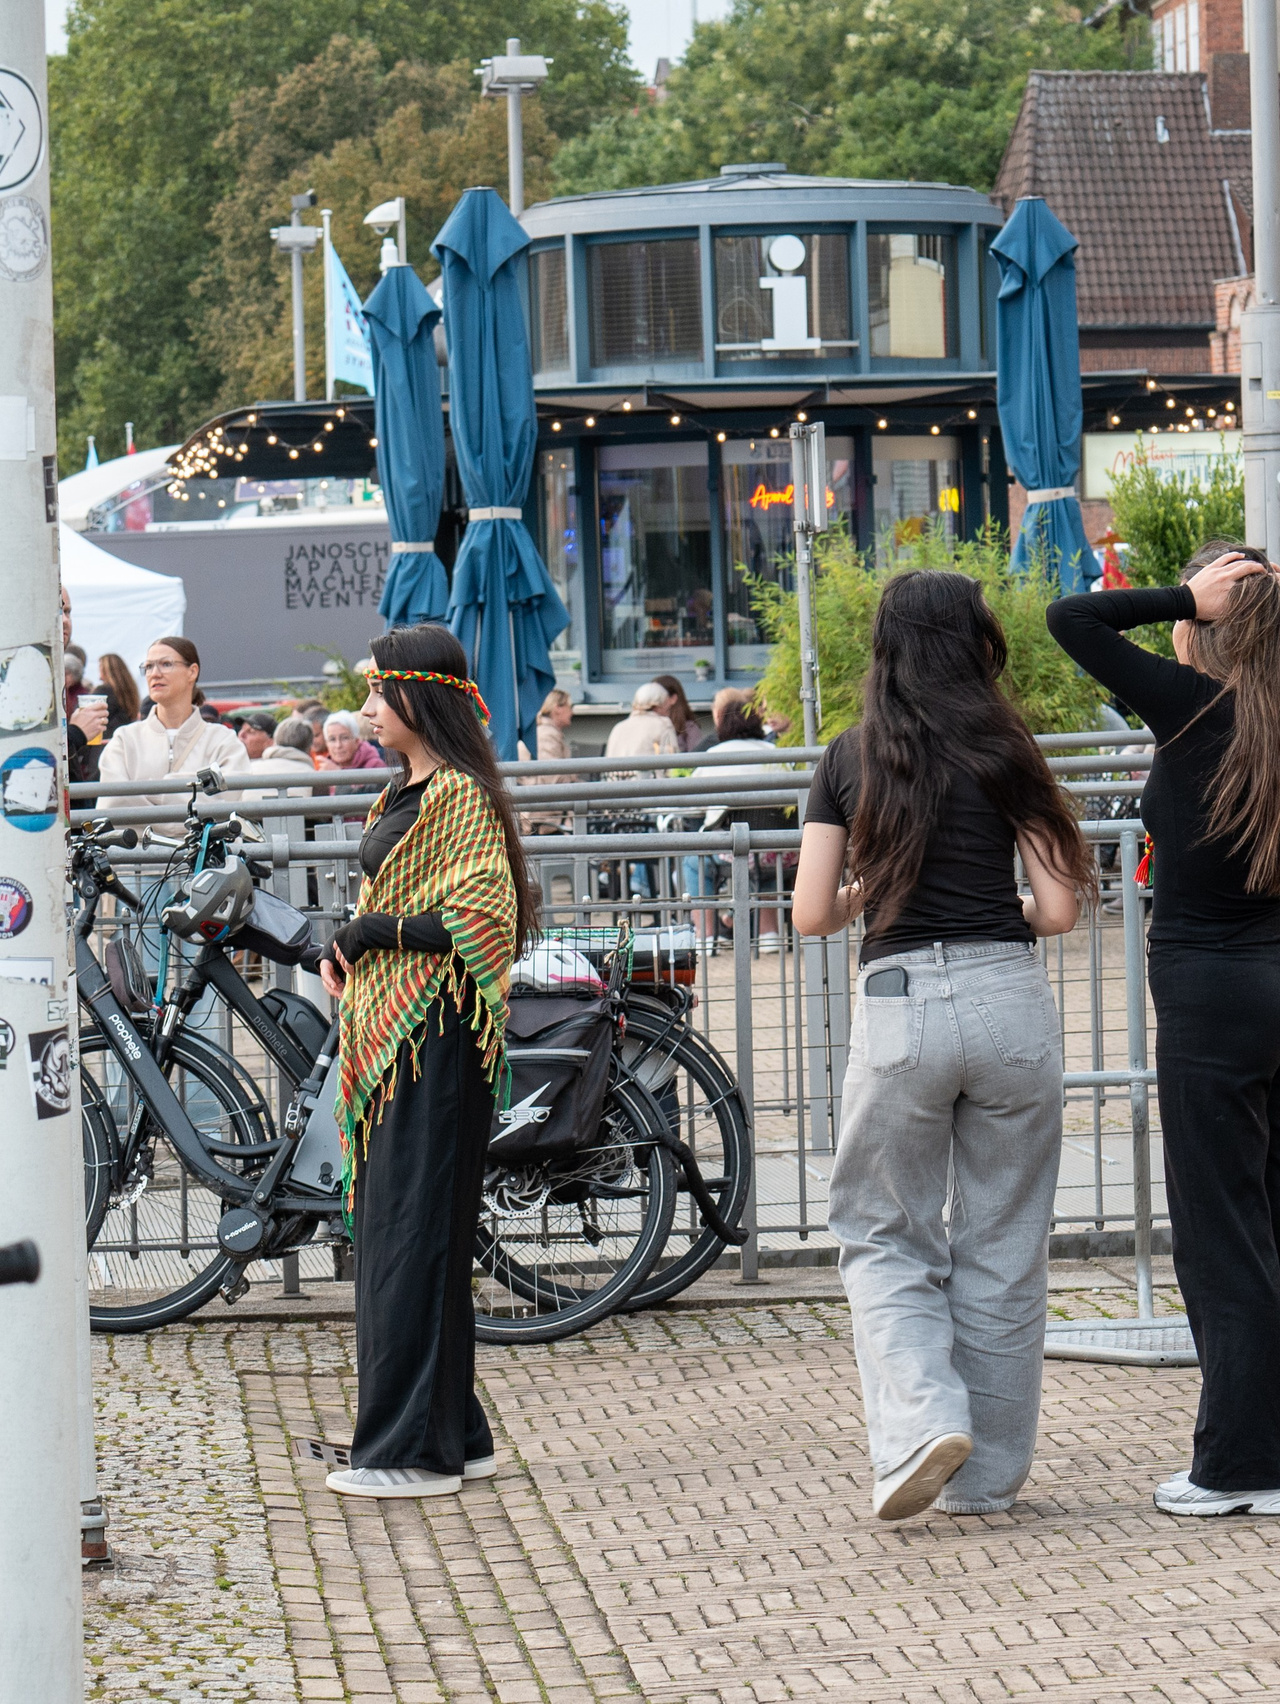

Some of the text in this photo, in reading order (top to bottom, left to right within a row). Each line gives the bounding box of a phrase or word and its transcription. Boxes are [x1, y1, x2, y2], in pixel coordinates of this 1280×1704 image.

[1113, 440, 1177, 473] Matini
[285, 542, 388, 561] JANOSCH
[285, 559, 387, 577] & PAUL
[286, 590, 381, 609] EVENTS
[108, 1013, 142, 1060] prophete
[254, 1015, 288, 1056] prophete
[224, 1220, 258, 1240] e-novation
